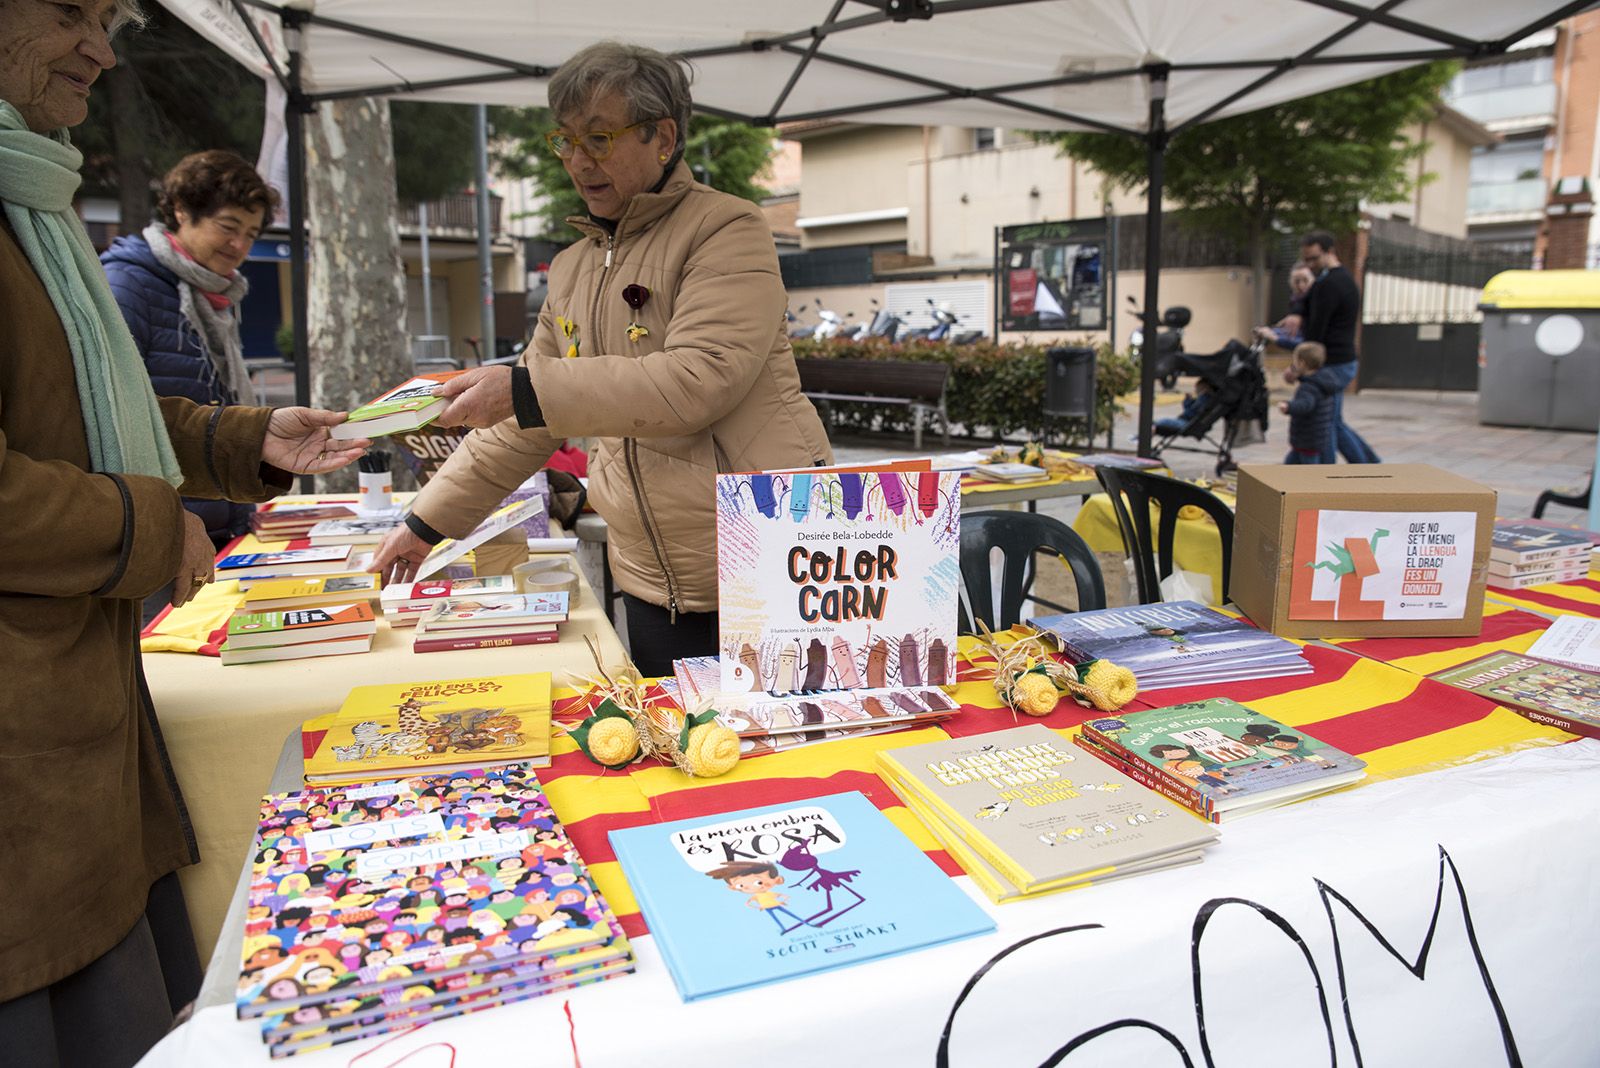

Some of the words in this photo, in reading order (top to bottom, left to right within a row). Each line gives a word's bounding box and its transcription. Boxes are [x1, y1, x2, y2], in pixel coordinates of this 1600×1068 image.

[798, 531, 830, 540] Desirée
[832, 530, 894, 540] Bela-Lobedde
[1409, 522, 1426, 533] QUE
[1428, 522, 1440, 533] NO
[1428, 534, 1455, 544] MENGI
[1407, 546, 1418, 556] LA
[1419, 546, 1456, 556] LLENGUA
[1406, 558, 1416, 568] EL
[1418, 558, 1444, 568] DRAC!
[1406, 570, 1422, 580] FES
[1423, 570, 1436, 580] UN
[1403, 583, 1440, 594] DONATIU
[1072, 604, 1201, 632] INVISIBLES
[807, 626, 821, 634] Lydia
[400, 684, 503, 698] FELIÇOS?
[410, 684, 442, 692] QUÈ
[1528, 712, 1570, 728] LLUITADORES
[1130, 732, 1154, 746] Què
[1168, 719, 1184, 730] el
[1185, 716, 1255, 727] racisme?
[927, 760, 961, 775] LA
[958, 742, 1058, 770] IGUALTAT
[936, 763, 1012, 787] ENTRE
[1006, 750, 1076, 772] NOIES
[986, 776, 1004, 789] I
[1000, 766, 1062, 788] NOIS
[1133, 757, 1146, 770] Què
[1146, 764, 1154, 774] és
[1154, 770, 1161, 779] el
[1162, 774, 1188, 794] racisme?
[1000, 790, 1026, 802] NO
[1043, 778, 1076, 792] CAP
[1022, 789, 1082, 808] BROMA
[1132, 770, 1146, 783] Què
[1147, 778, 1154, 788] és
[1156, 784, 1162, 792] el
[1163, 788, 1192, 808] racisme?
[318, 817, 430, 846] TOTS
[708, 824, 756, 840] meva
[762, 812, 824, 831] ombra
[687, 843, 714, 856] és
[721, 824, 841, 862] ROSA
[1090, 832, 1144, 850] LAROUSSE
[363, 835, 524, 869] COMPTEM
[766, 940, 818, 959] SCOTT
[834, 922, 898, 943] STUART
